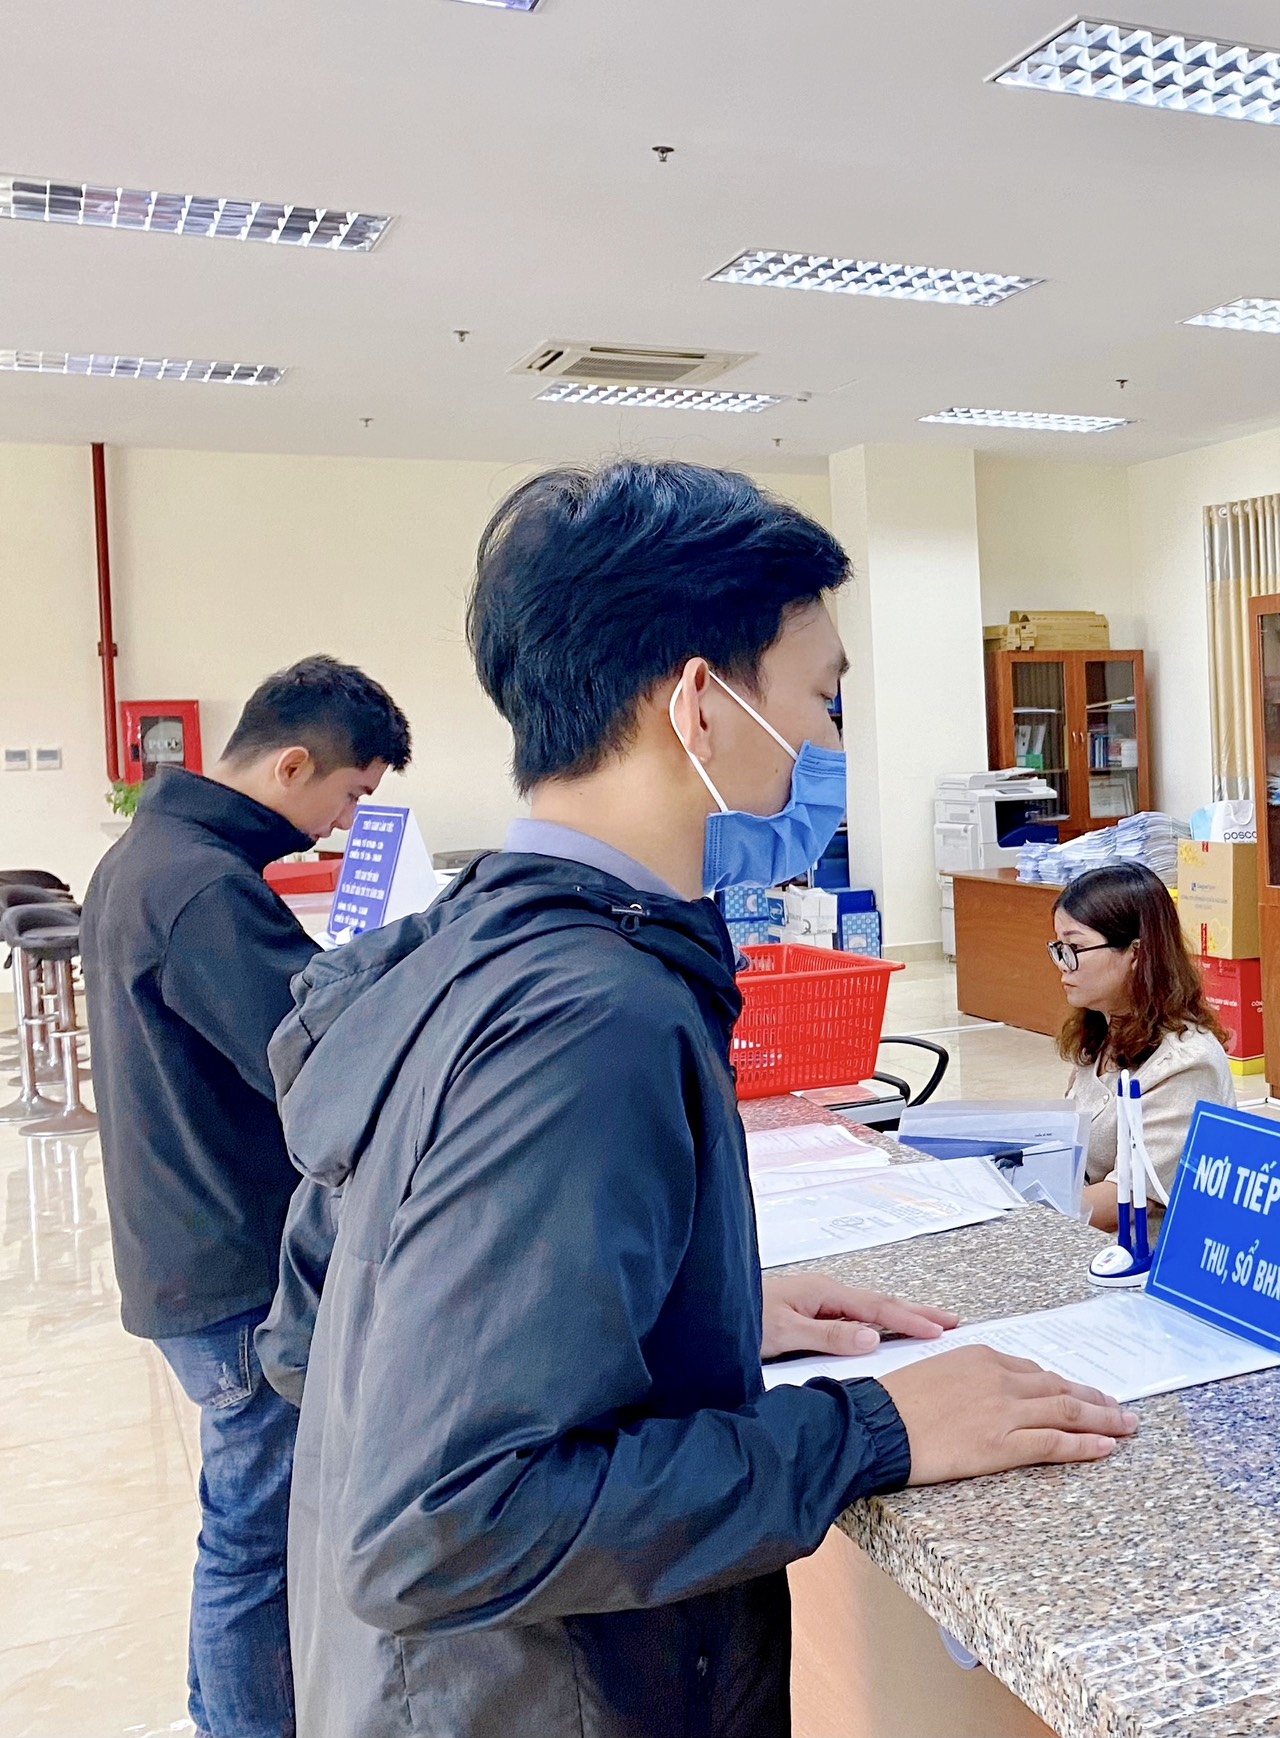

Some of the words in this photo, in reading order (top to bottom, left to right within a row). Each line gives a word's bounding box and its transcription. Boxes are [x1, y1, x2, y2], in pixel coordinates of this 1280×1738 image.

[1193, 1154, 1231, 1199] NƠI
[1199, 1237, 1229, 1286] THU,
[1231, 1238, 1259, 1287] SỔ
